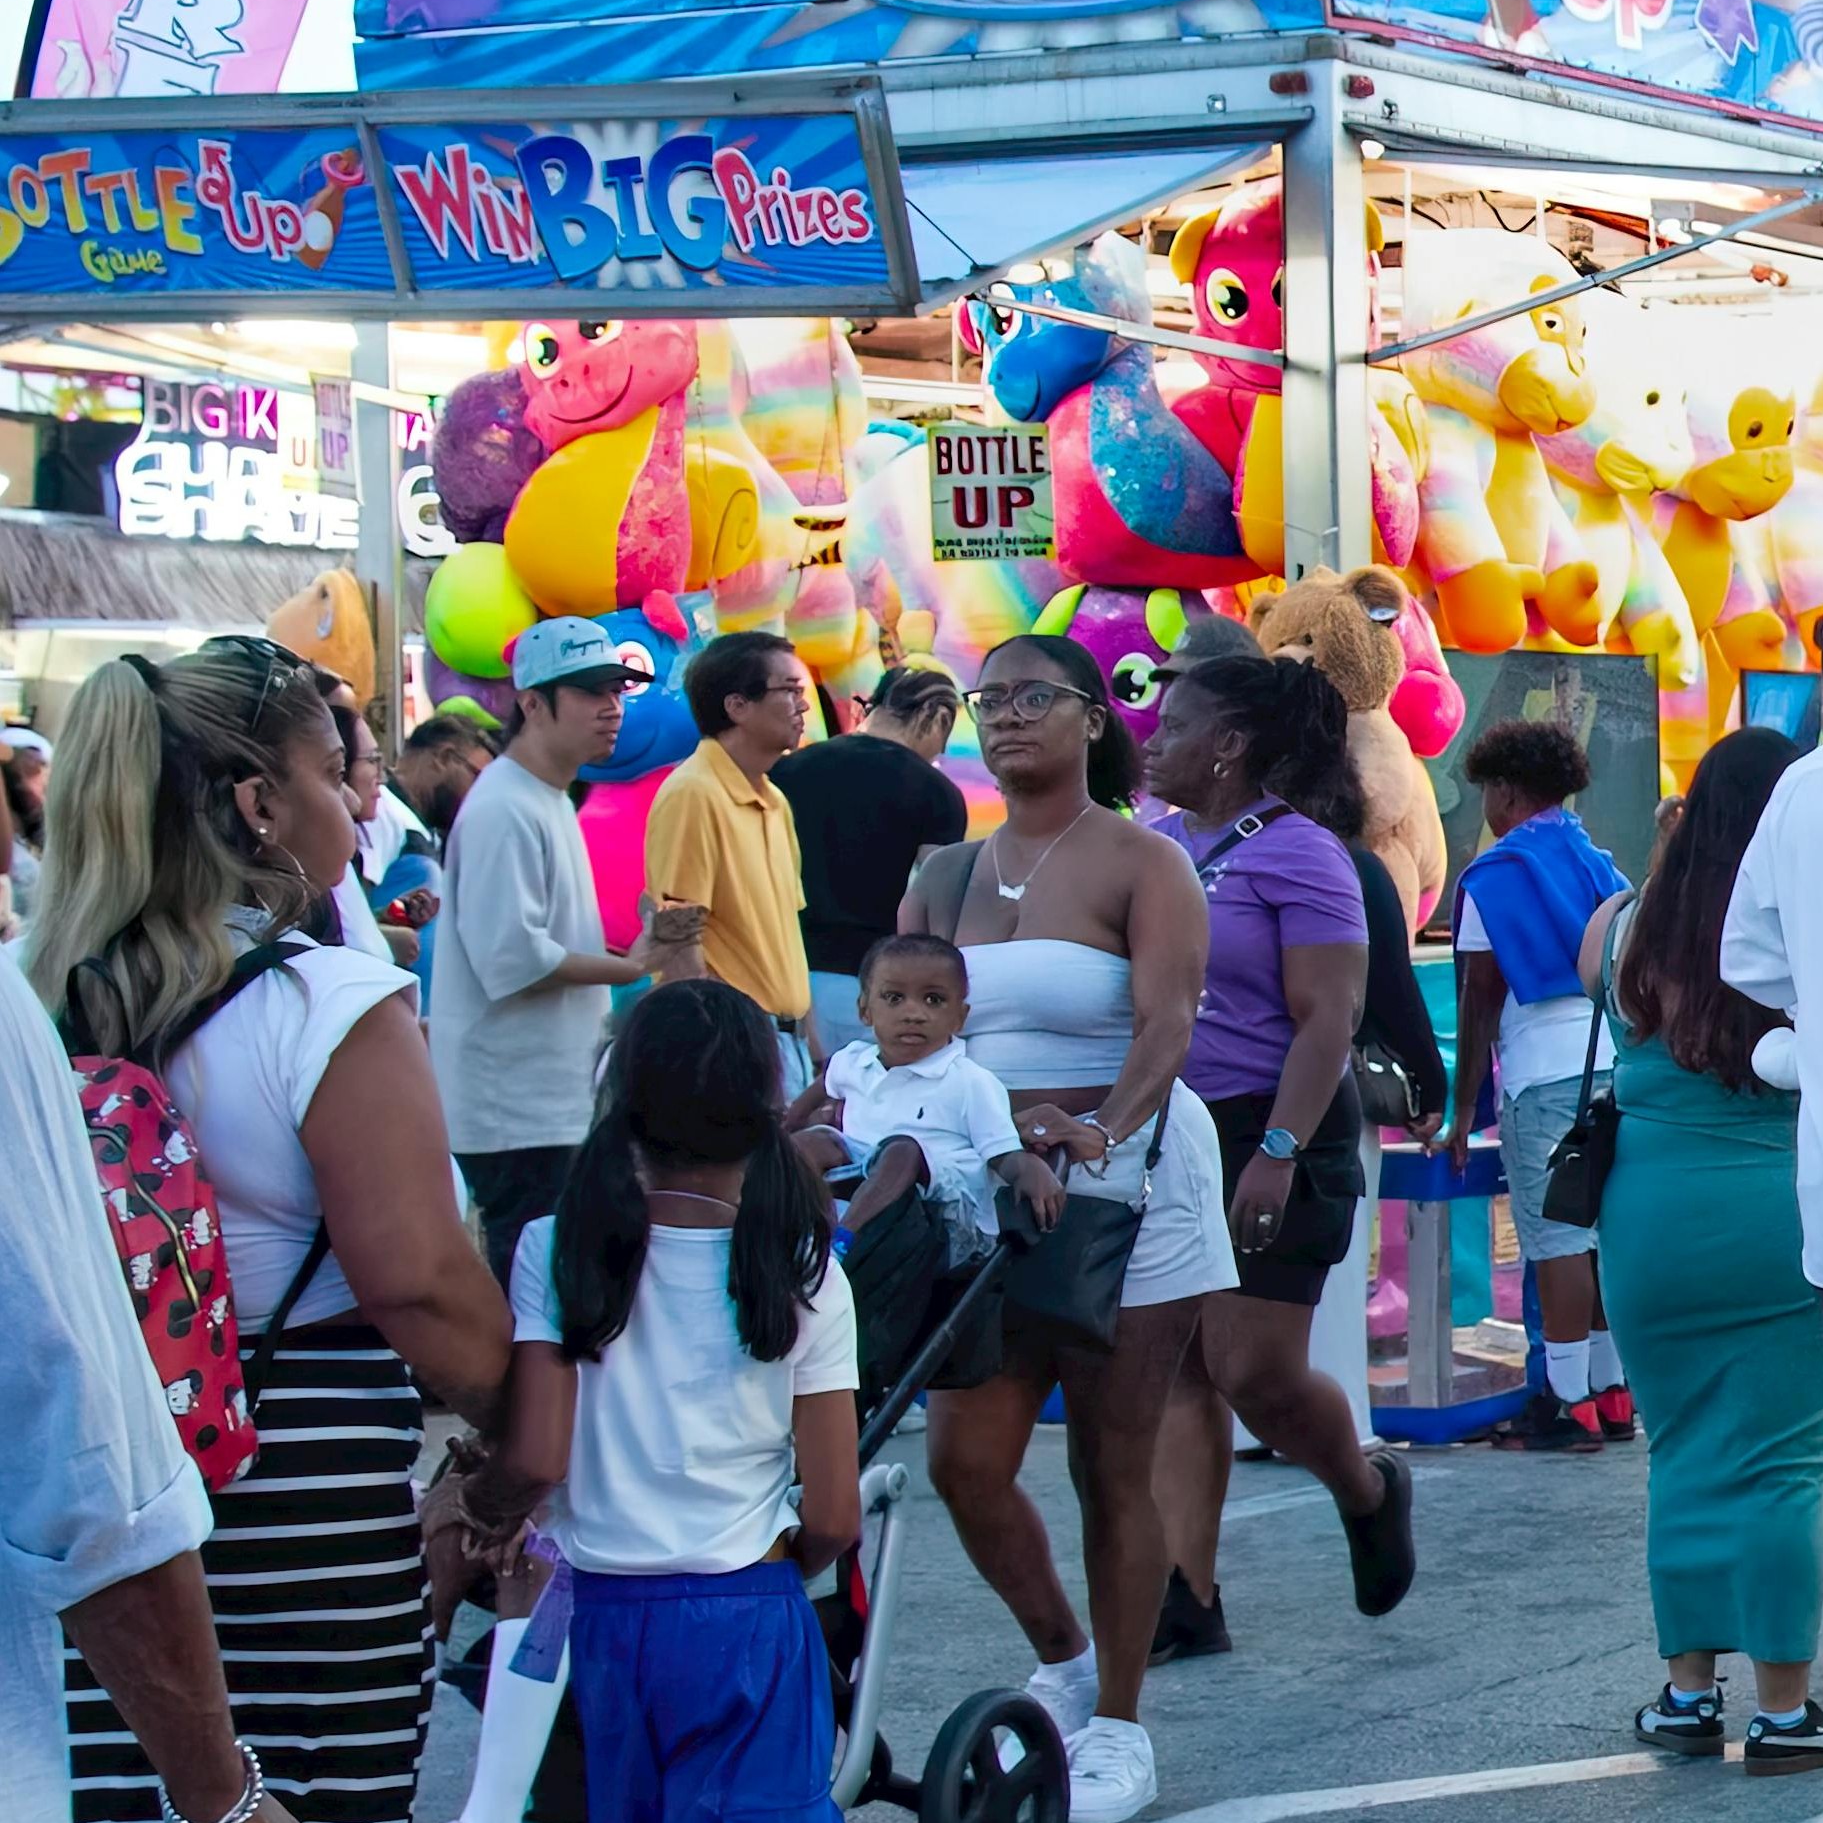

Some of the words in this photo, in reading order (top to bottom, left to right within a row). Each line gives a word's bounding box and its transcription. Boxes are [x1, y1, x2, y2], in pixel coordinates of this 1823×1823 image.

[197, 138, 303, 263] Up
[517, 134, 726, 281] BIG
[712, 147, 874, 255] Prizes
[80, 239, 167, 283] Game
[144, 379, 229, 437] BIG
[936, 435, 1046, 476] BOTTLE
[952, 485, 1035, 529] UP
